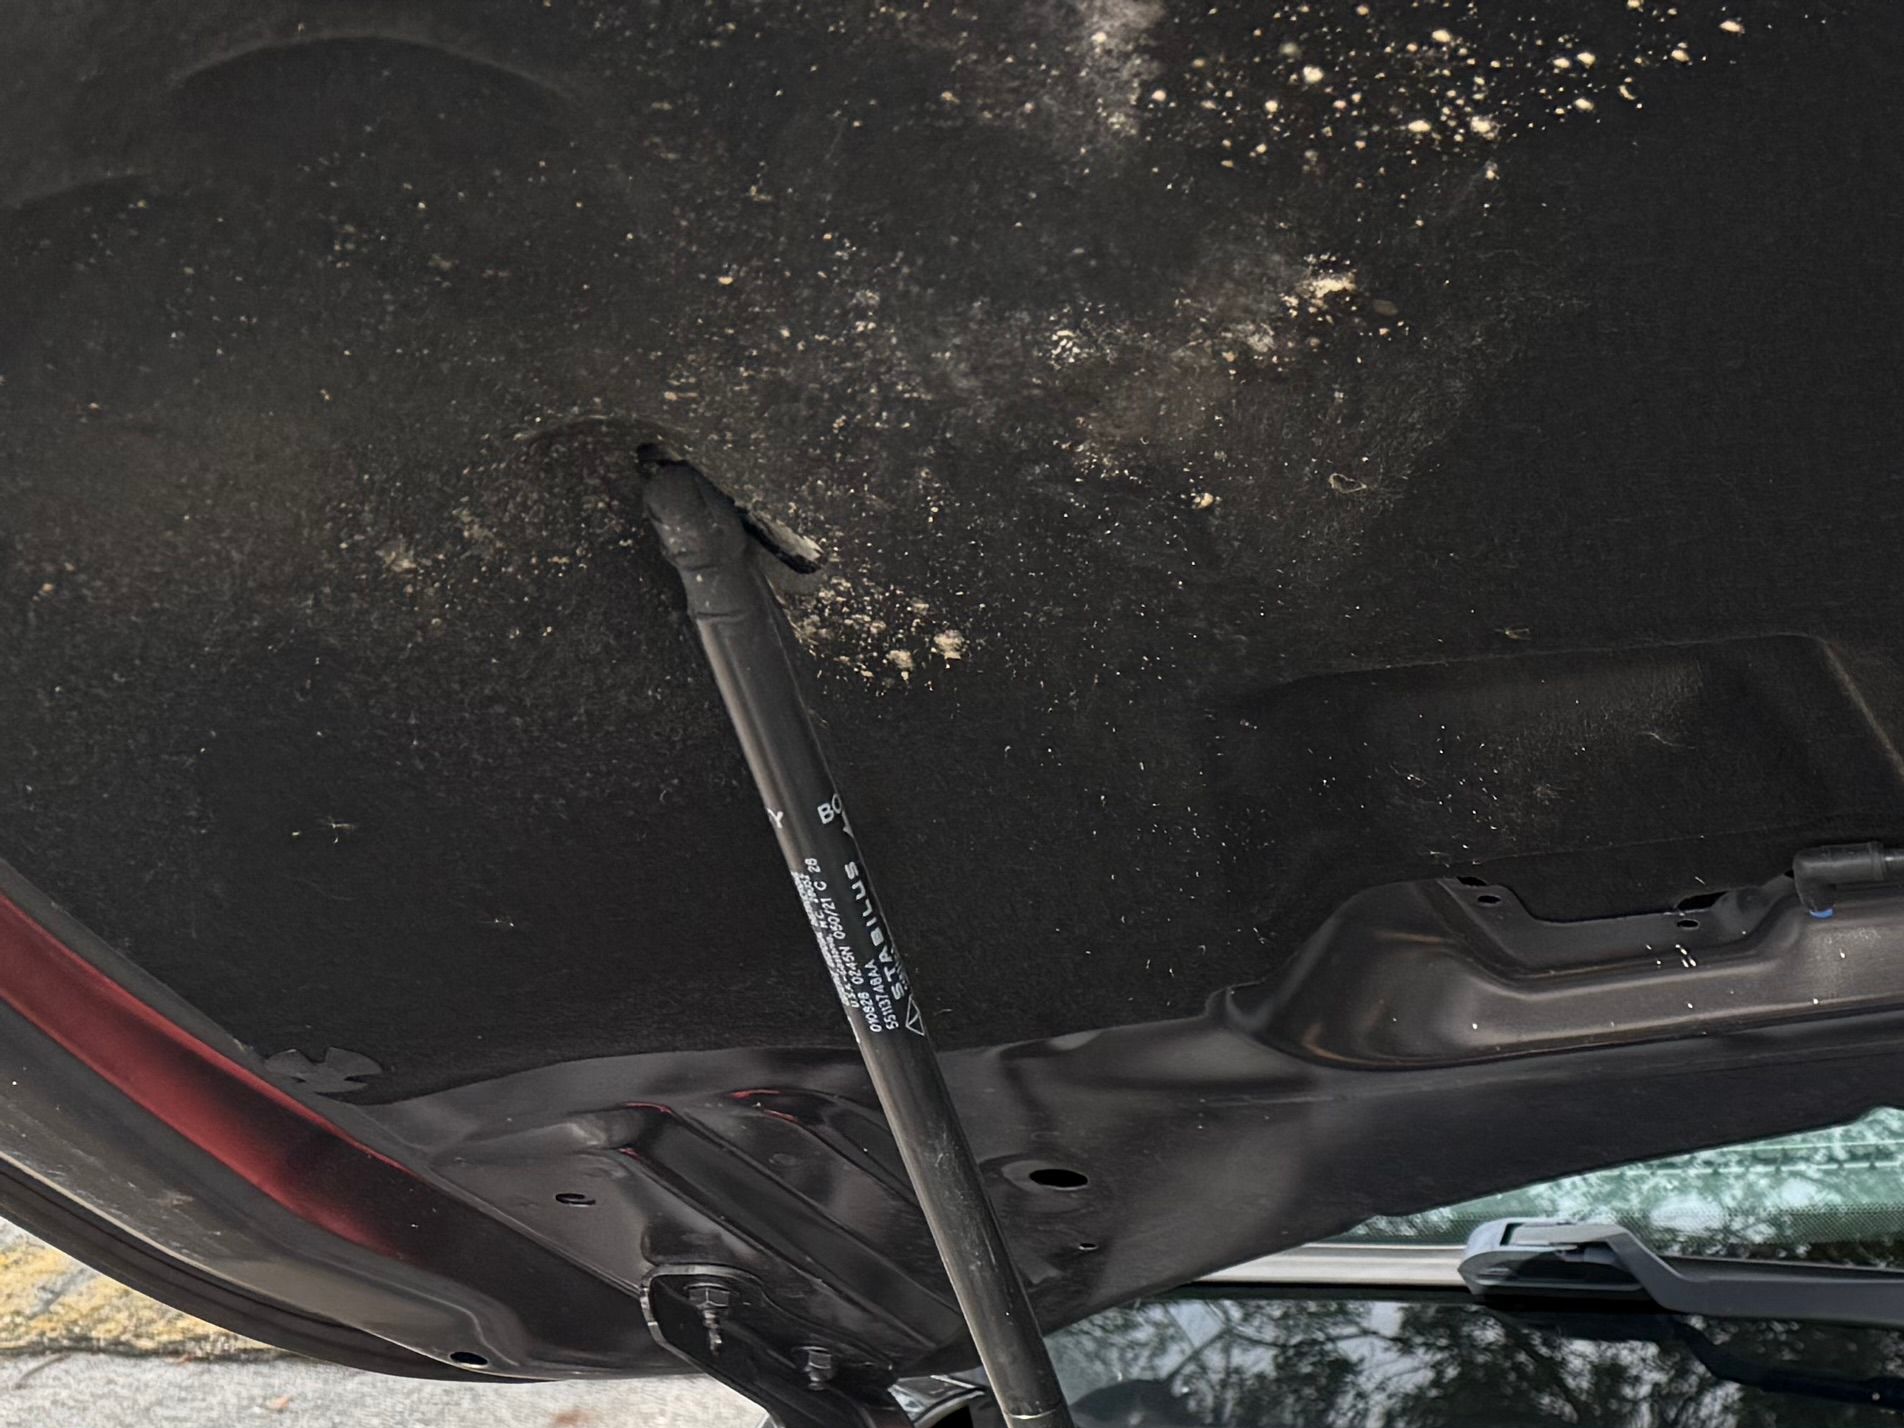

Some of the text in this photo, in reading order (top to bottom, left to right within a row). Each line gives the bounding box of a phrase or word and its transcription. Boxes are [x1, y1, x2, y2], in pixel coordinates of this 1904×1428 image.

[813, 878, 827, 892] C
[820, 895, 846, 941] 050/21
[844, 861, 905, 1000] STABILUS
